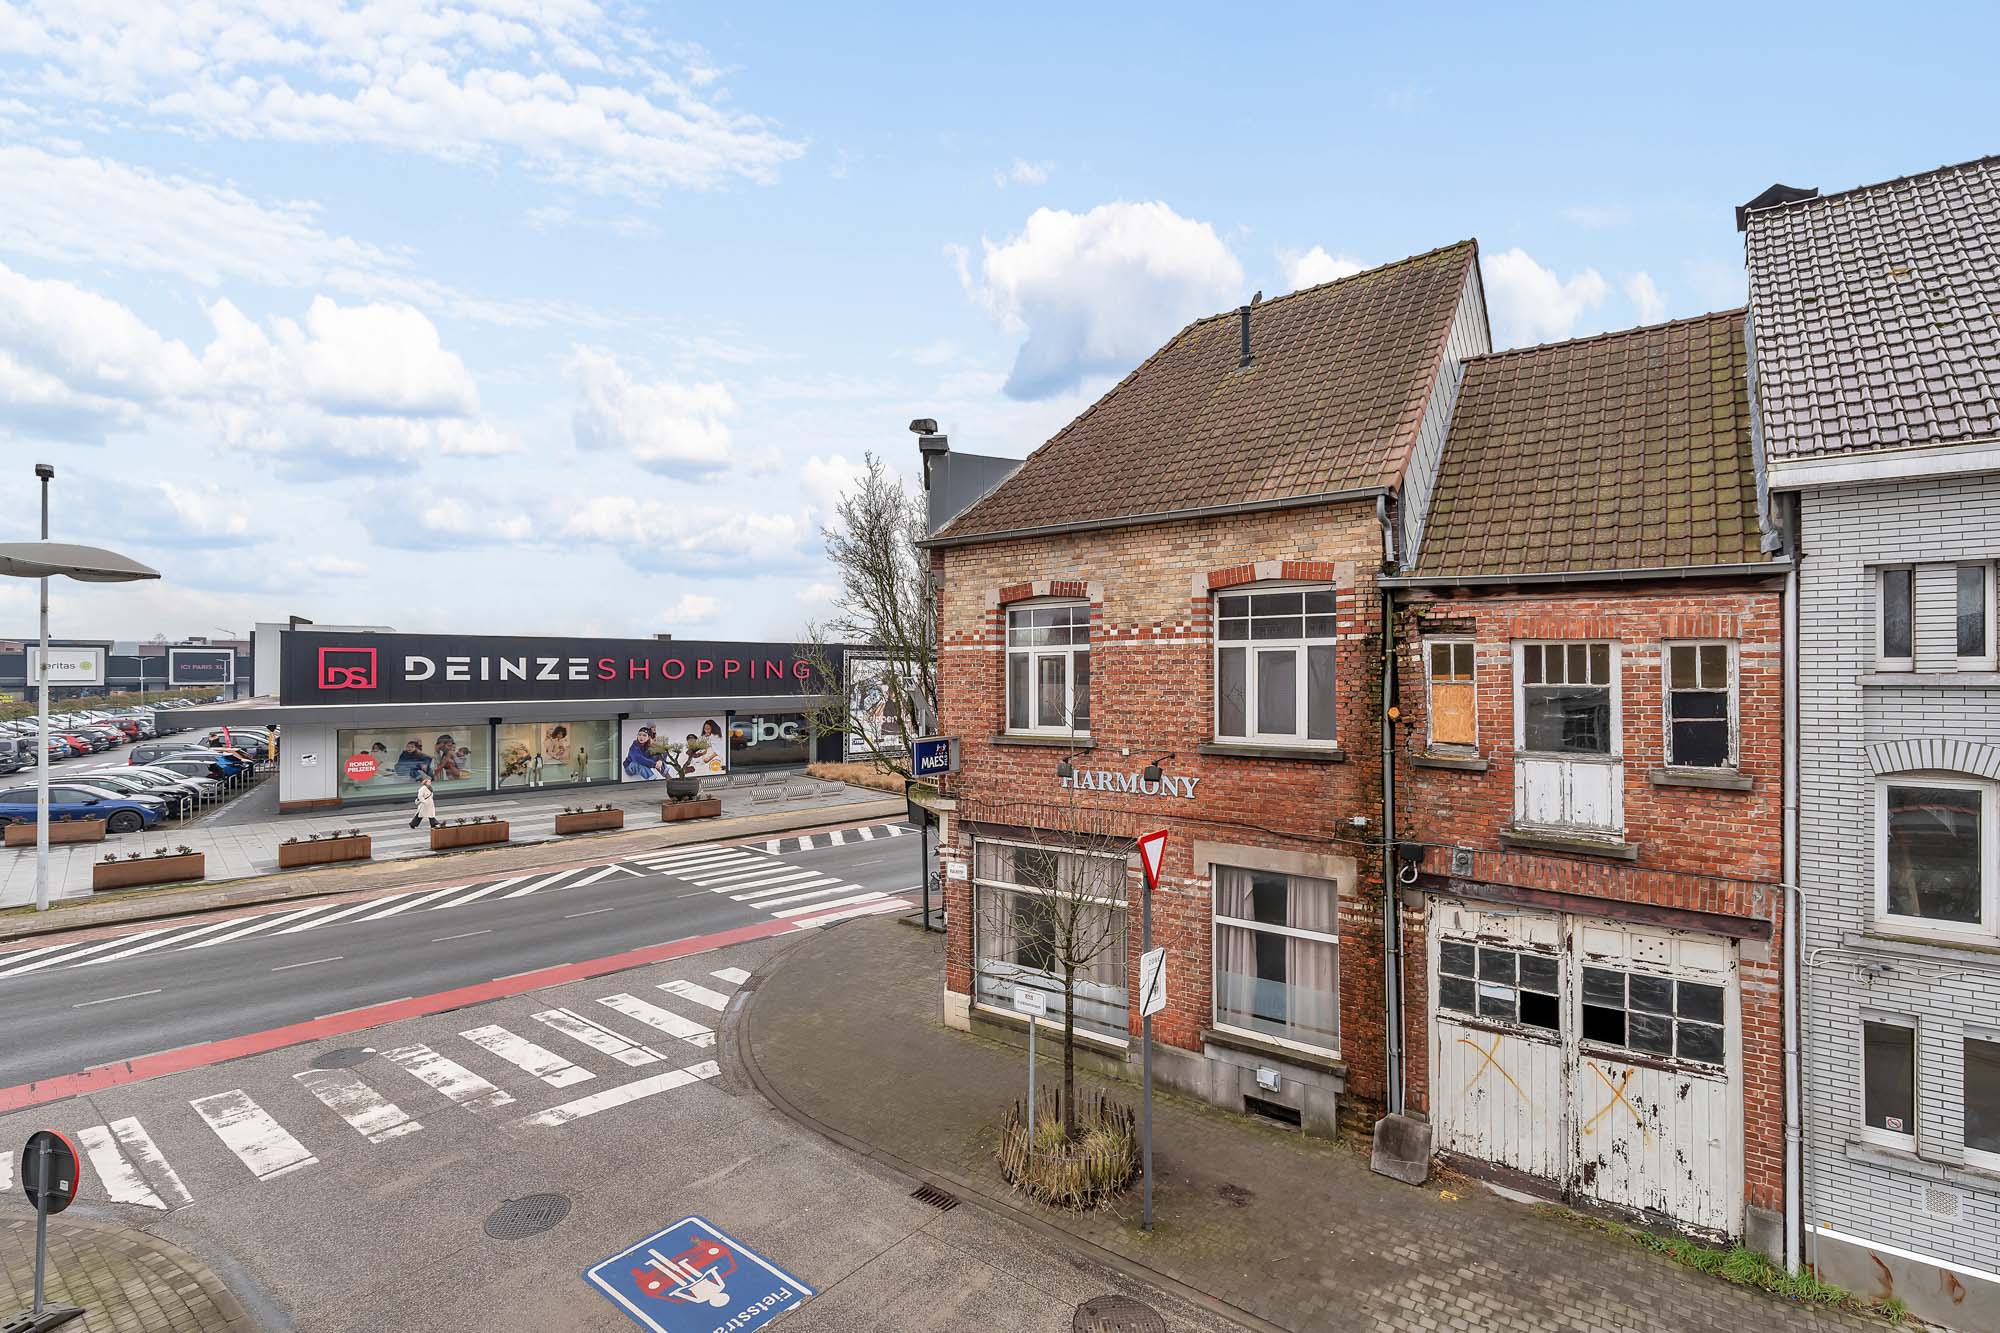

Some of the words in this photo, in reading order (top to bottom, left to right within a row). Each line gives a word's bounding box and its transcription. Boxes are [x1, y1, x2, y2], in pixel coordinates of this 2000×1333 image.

[46, 662, 76, 670] eritas
[747, 718, 799, 746] jbc
[920, 755, 944, 769] MAES
[1061, 769, 1200, 799] HARMONY
